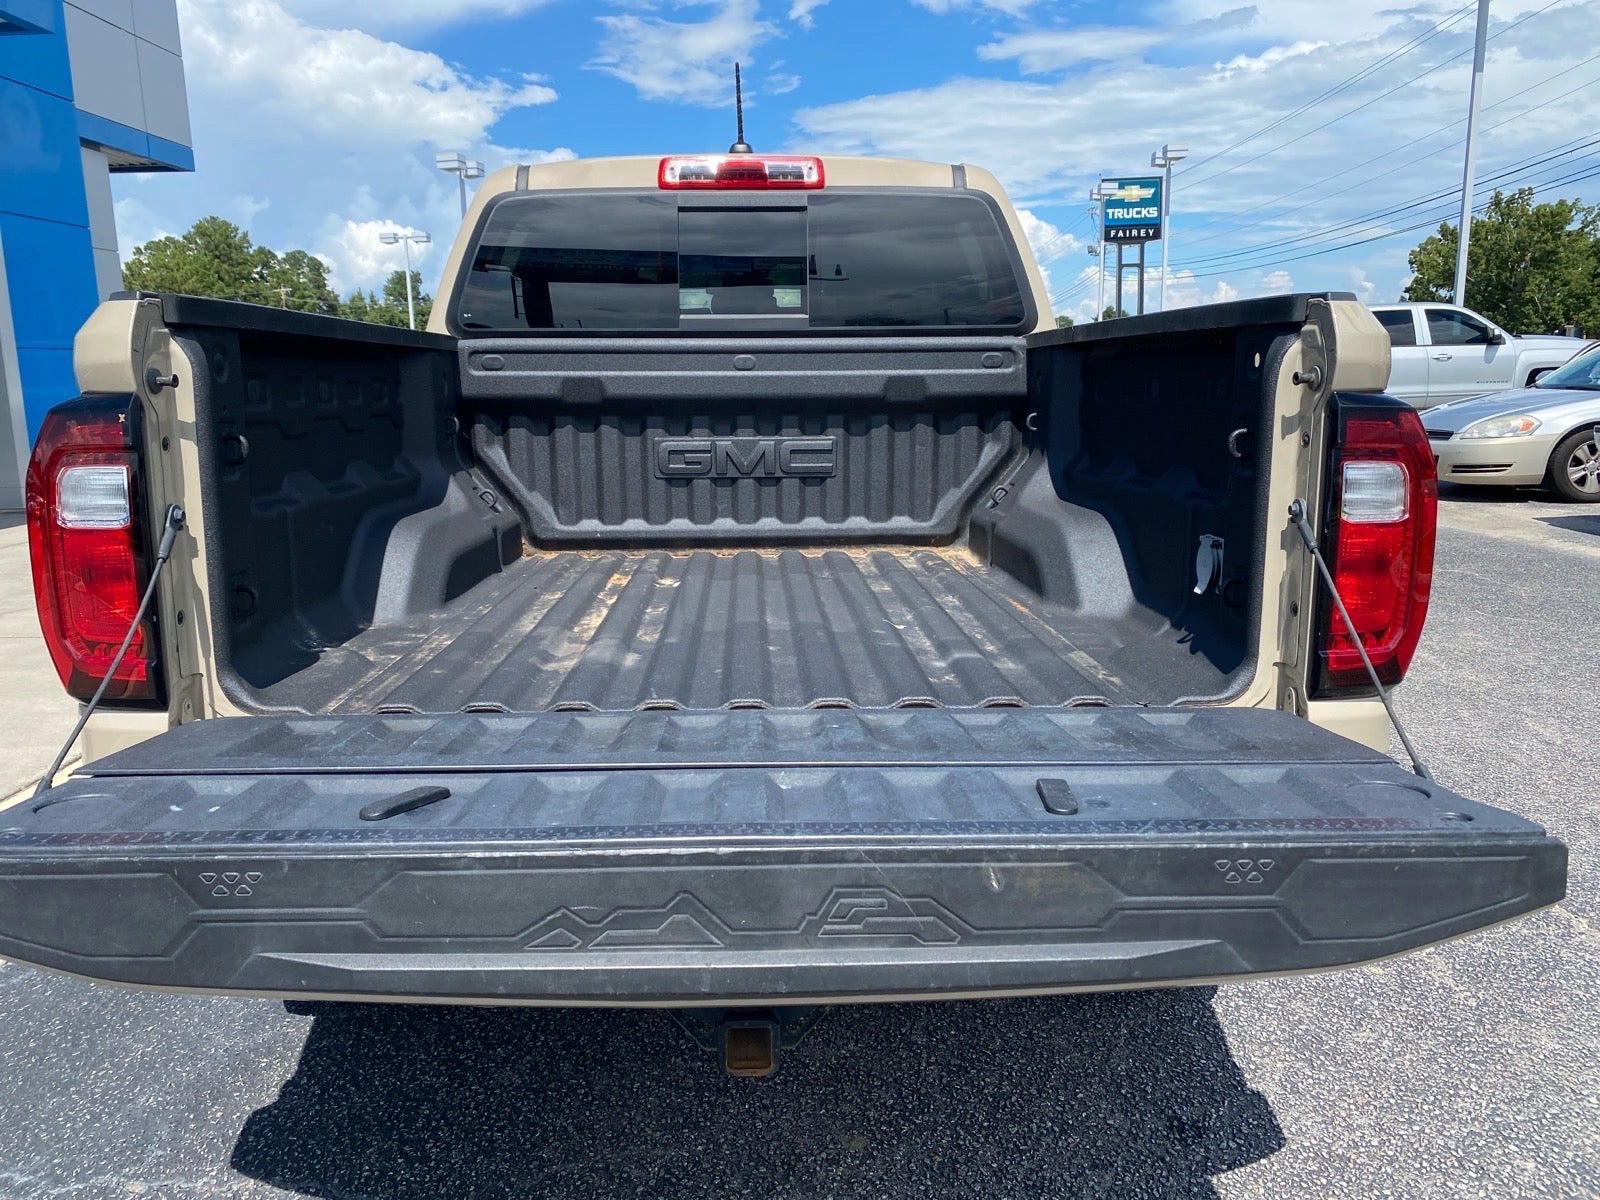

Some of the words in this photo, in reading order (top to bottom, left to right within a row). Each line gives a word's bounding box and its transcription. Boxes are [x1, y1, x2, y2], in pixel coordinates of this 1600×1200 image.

[1106, 207, 1158, 219] TRUCKS
[1110, 229, 1154, 238] FAIREY
[658, 440, 834, 475] GMC
